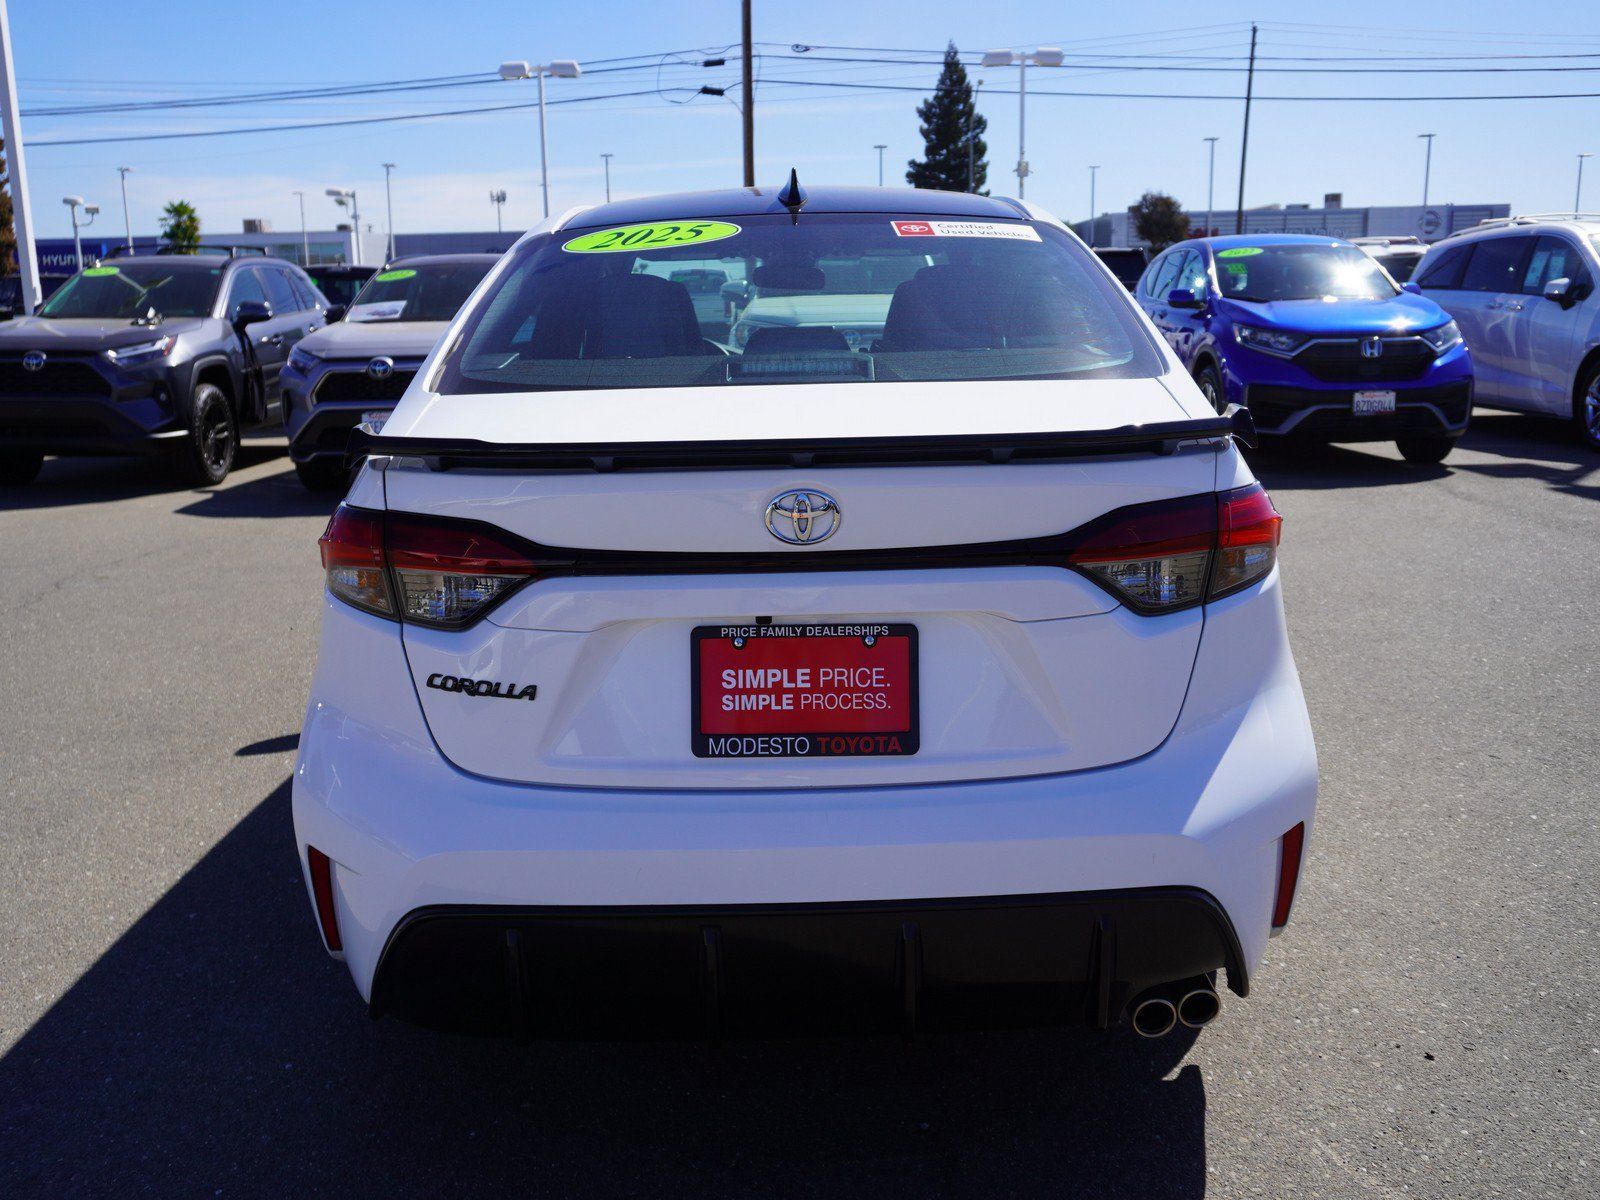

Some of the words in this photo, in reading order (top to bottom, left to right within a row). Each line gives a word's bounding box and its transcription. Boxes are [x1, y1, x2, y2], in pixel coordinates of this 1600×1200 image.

[588, 224, 712, 250] 2025
[721, 628, 757, 637] PRICE
[760, 626, 802, 637] FAMILY
[806, 625, 889, 636] DEALERSHIPS
[426, 673, 538, 701] COROLLA
[721, 668, 811, 689] SIMPLE
[819, 667, 891, 688] PRICE.
[721, 694, 794, 711] SIMPLE
[800, 693, 892, 710] PROCESS.
[708, 736, 810, 755] MODESTO
[816, 736, 903, 754] TOYOTA
